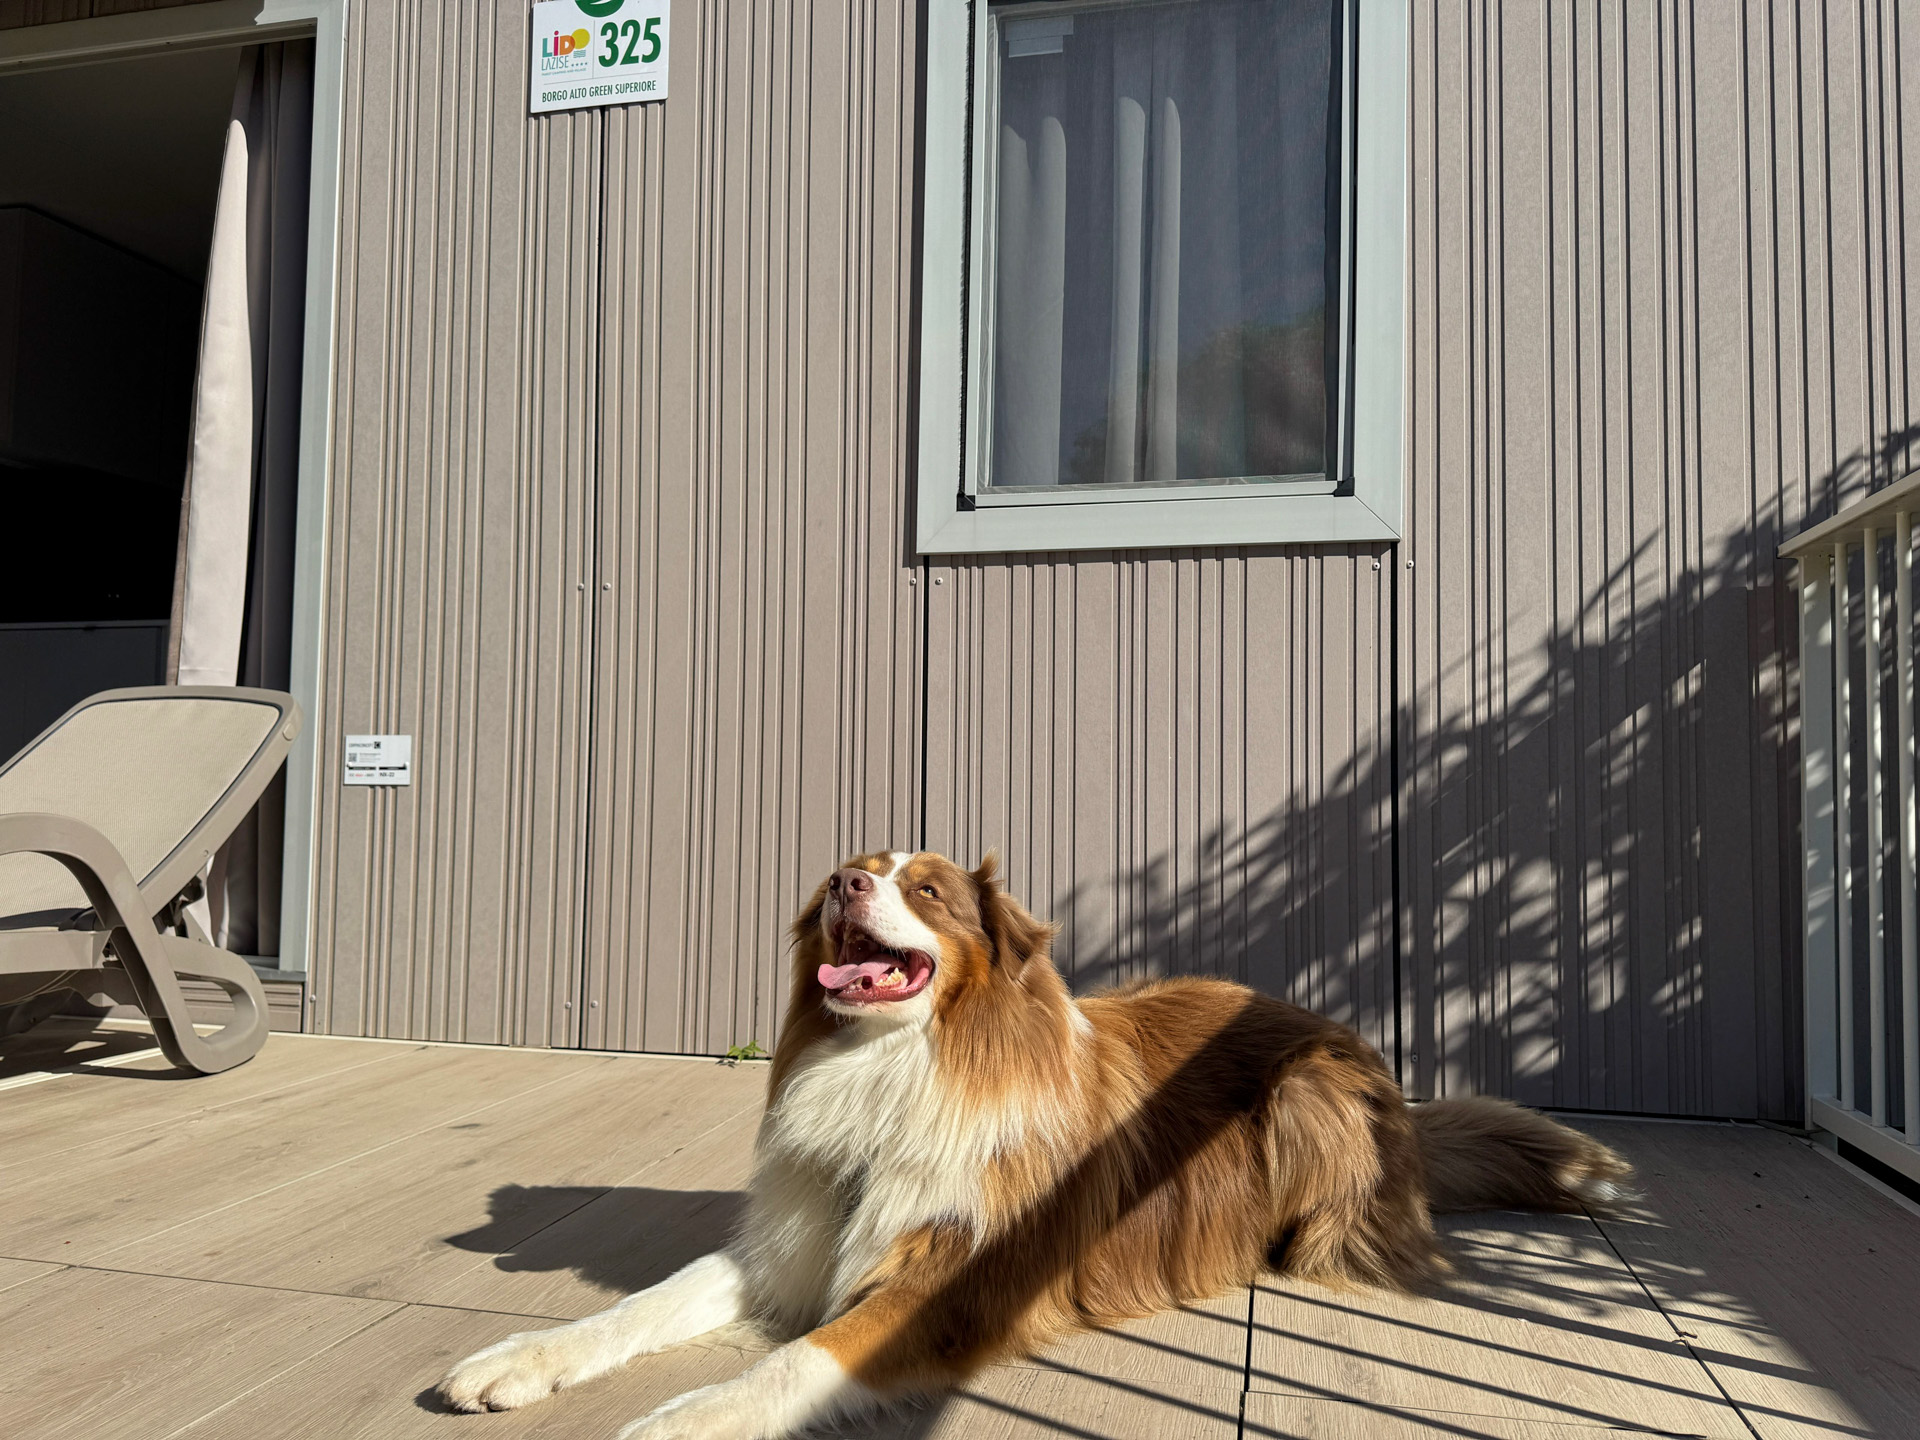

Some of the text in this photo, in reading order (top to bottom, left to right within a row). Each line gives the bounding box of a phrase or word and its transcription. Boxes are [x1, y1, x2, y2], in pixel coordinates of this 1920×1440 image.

[598, 17, 661, 67] 325
[541, 55, 569, 71] LAZISE
[542, 80, 657, 102] BORGO ALTO GREEN SUPERIORE
